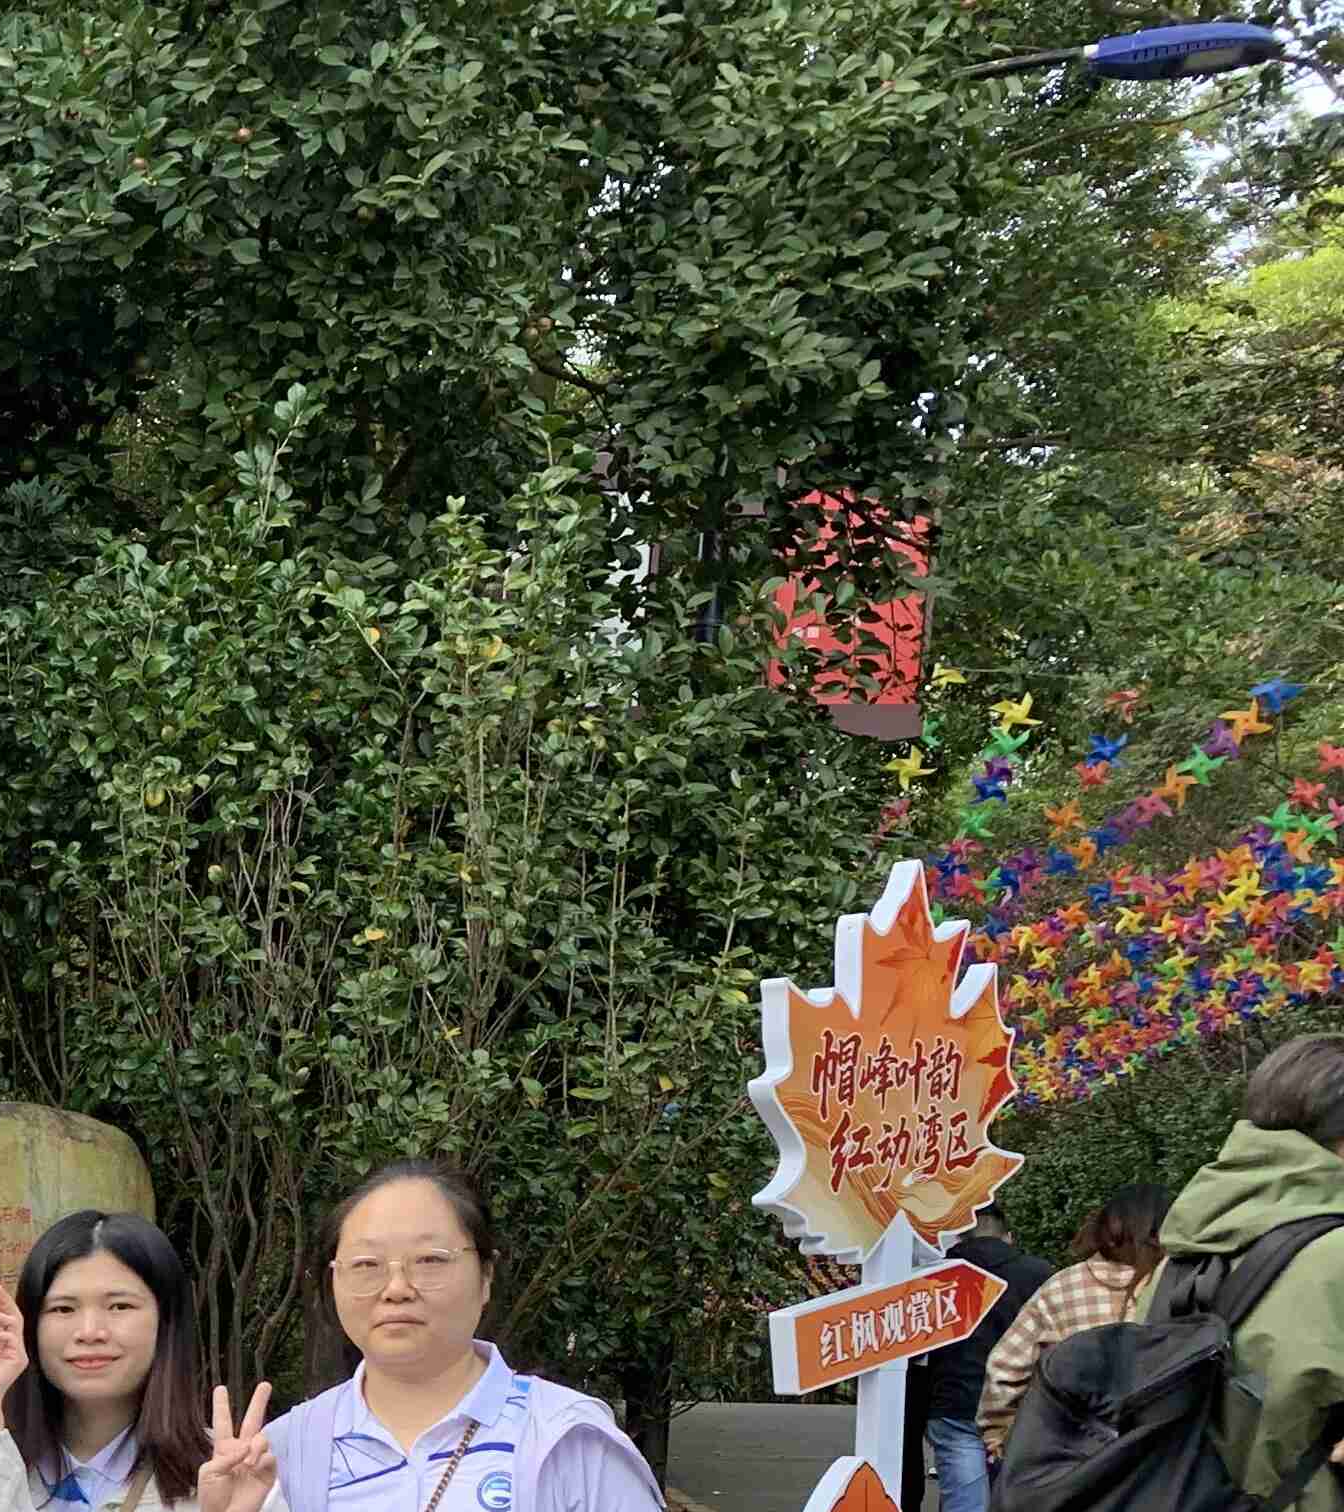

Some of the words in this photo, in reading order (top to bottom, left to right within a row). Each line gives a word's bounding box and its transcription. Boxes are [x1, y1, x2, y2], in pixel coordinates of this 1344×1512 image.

[811, 1028, 962, 1119] 帽峰叶韵
[829, 1105, 986, 1195] 红动湾区
[819, 1281, 962, 1368] 红枫观赏区
